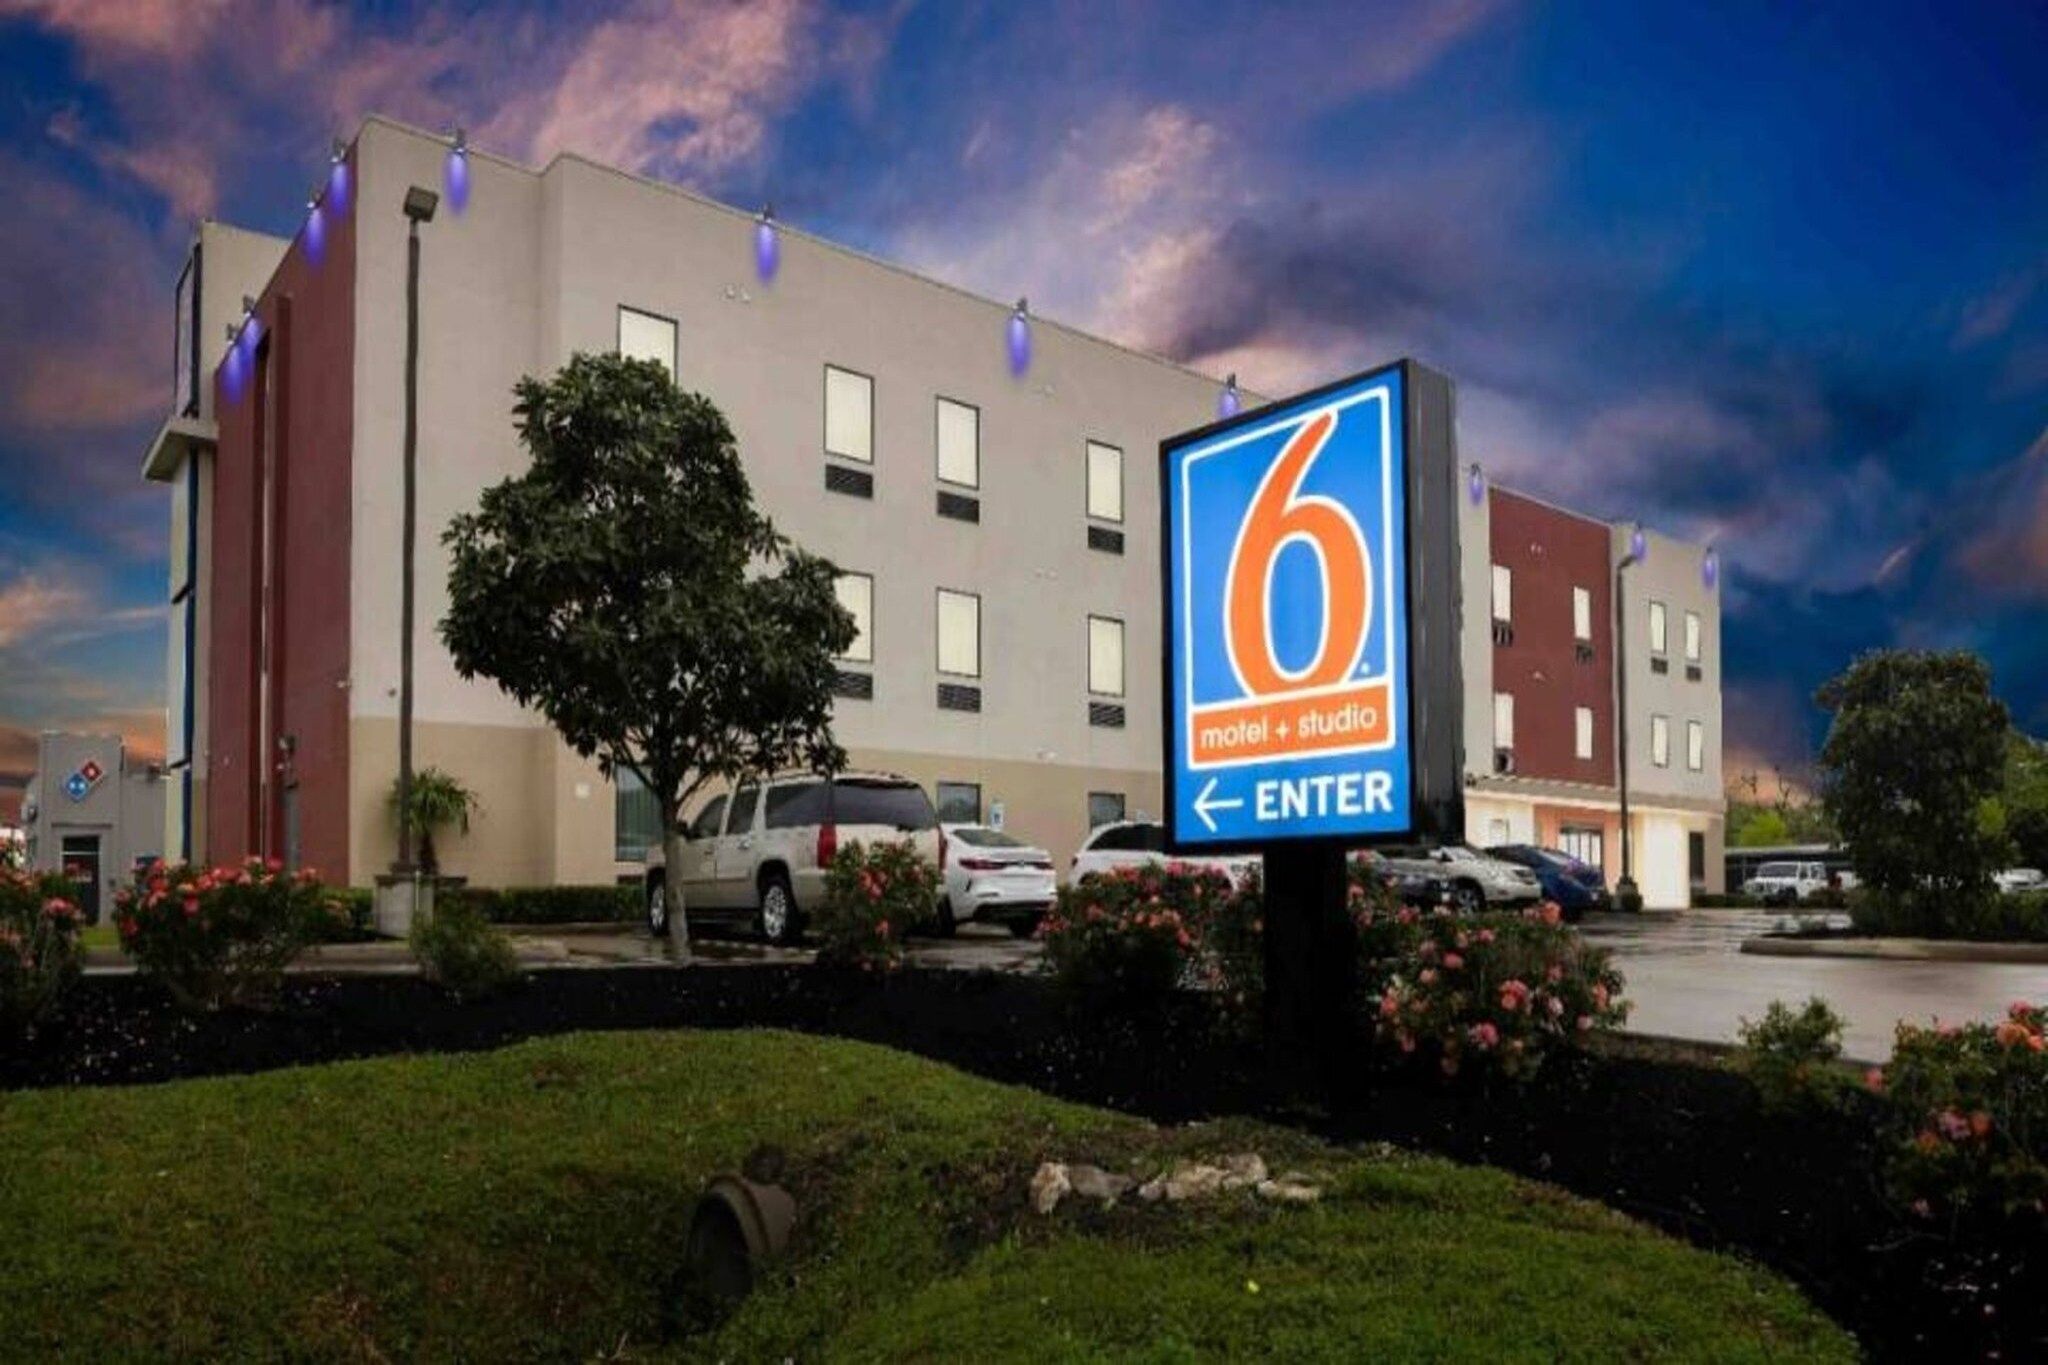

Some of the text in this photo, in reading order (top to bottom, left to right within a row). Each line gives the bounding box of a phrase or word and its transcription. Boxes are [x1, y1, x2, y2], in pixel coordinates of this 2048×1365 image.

[1223, 408, 1373, 699] 6
[1200, 715, 1269, 749] motel
[1298, 702, 1377, 738] studio
[1256, 769, 1395, 821] ENTER
